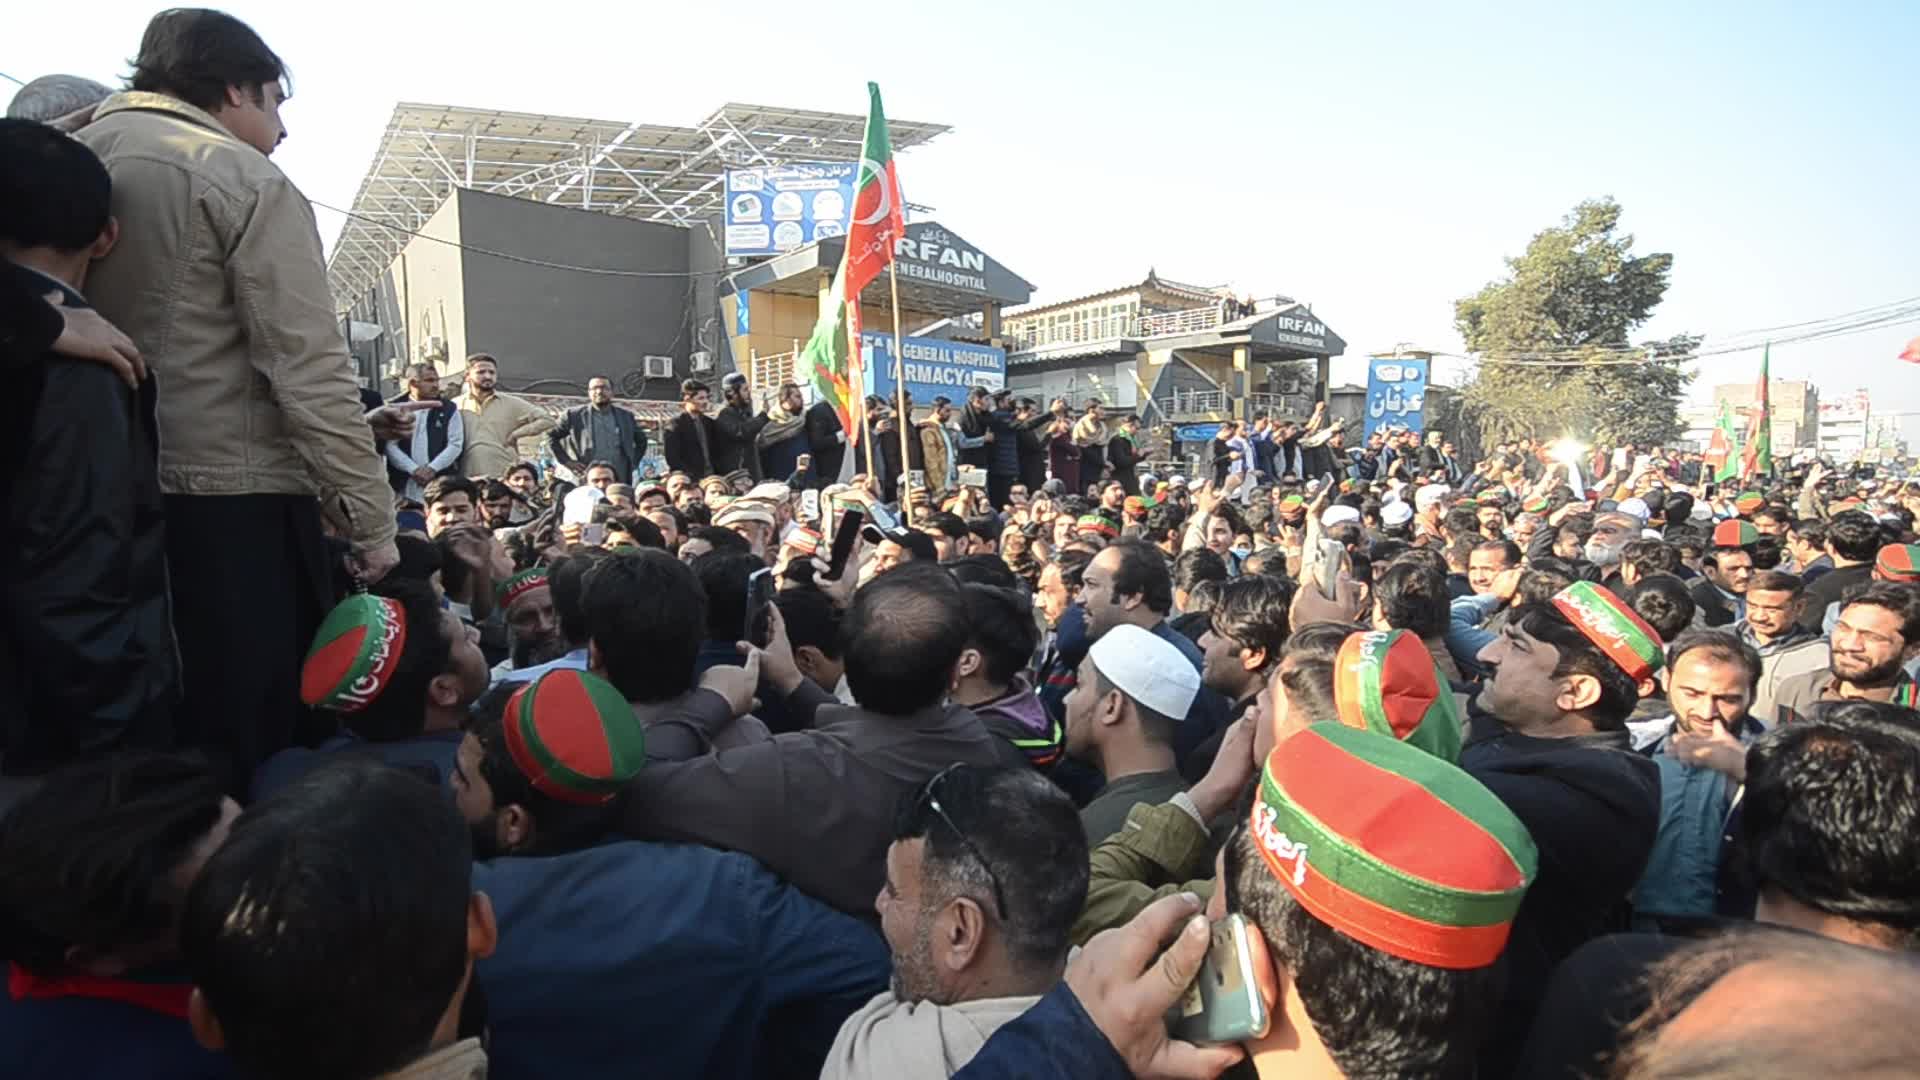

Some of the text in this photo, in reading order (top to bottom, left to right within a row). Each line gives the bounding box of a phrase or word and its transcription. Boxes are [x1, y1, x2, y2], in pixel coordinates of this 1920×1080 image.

[894, 238, 985, 272] RFAN
[1278, 316, 1325, 336] IRFAN
[903, 343, 951, 362] GENERAL
[953, 349, 1000, 369] HOSPITAL
[1371, 385, 1424, 418] عرفان
